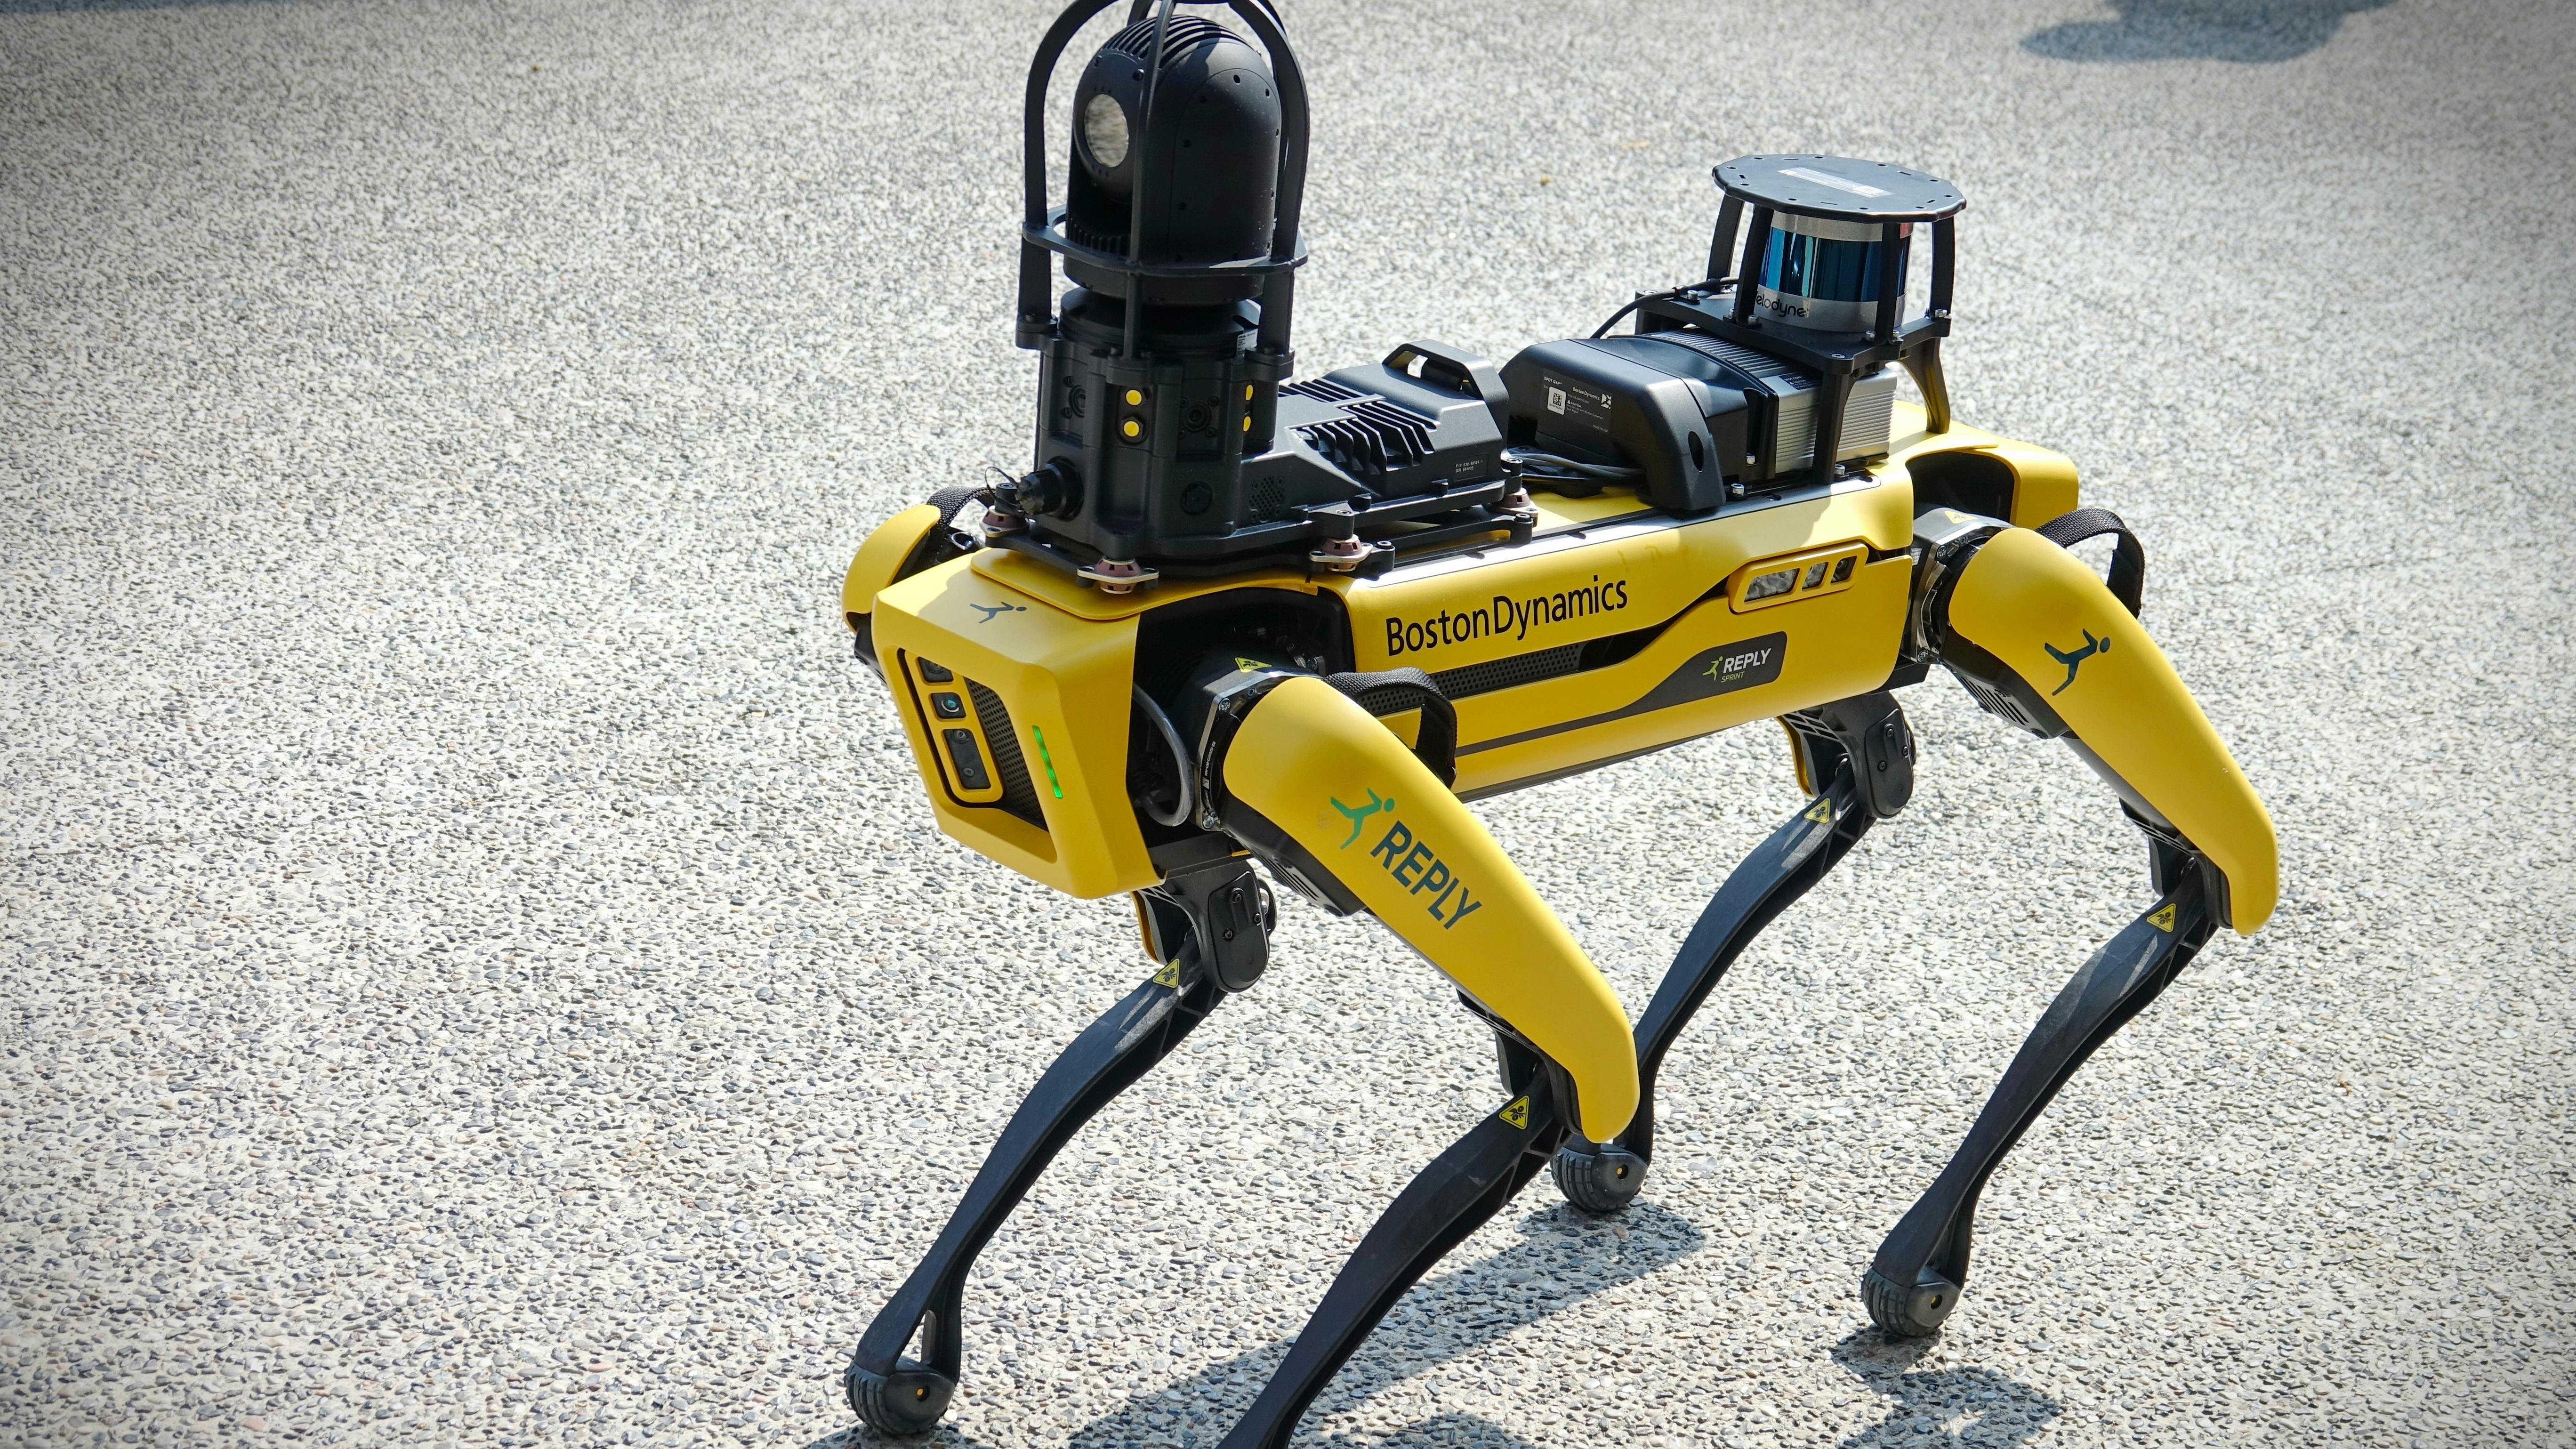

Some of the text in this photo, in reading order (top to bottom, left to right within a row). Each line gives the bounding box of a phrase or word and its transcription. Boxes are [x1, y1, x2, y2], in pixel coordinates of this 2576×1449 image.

[1756, 294, 1806, 317] elodyne
[1385, 574, 1628, 656] BostonDynamics
[1723, 648, 1771, 674] REPLY
[1721, 671, 1745, 683] SPRINT
[1370, 820, 1482, 930] REPLY
